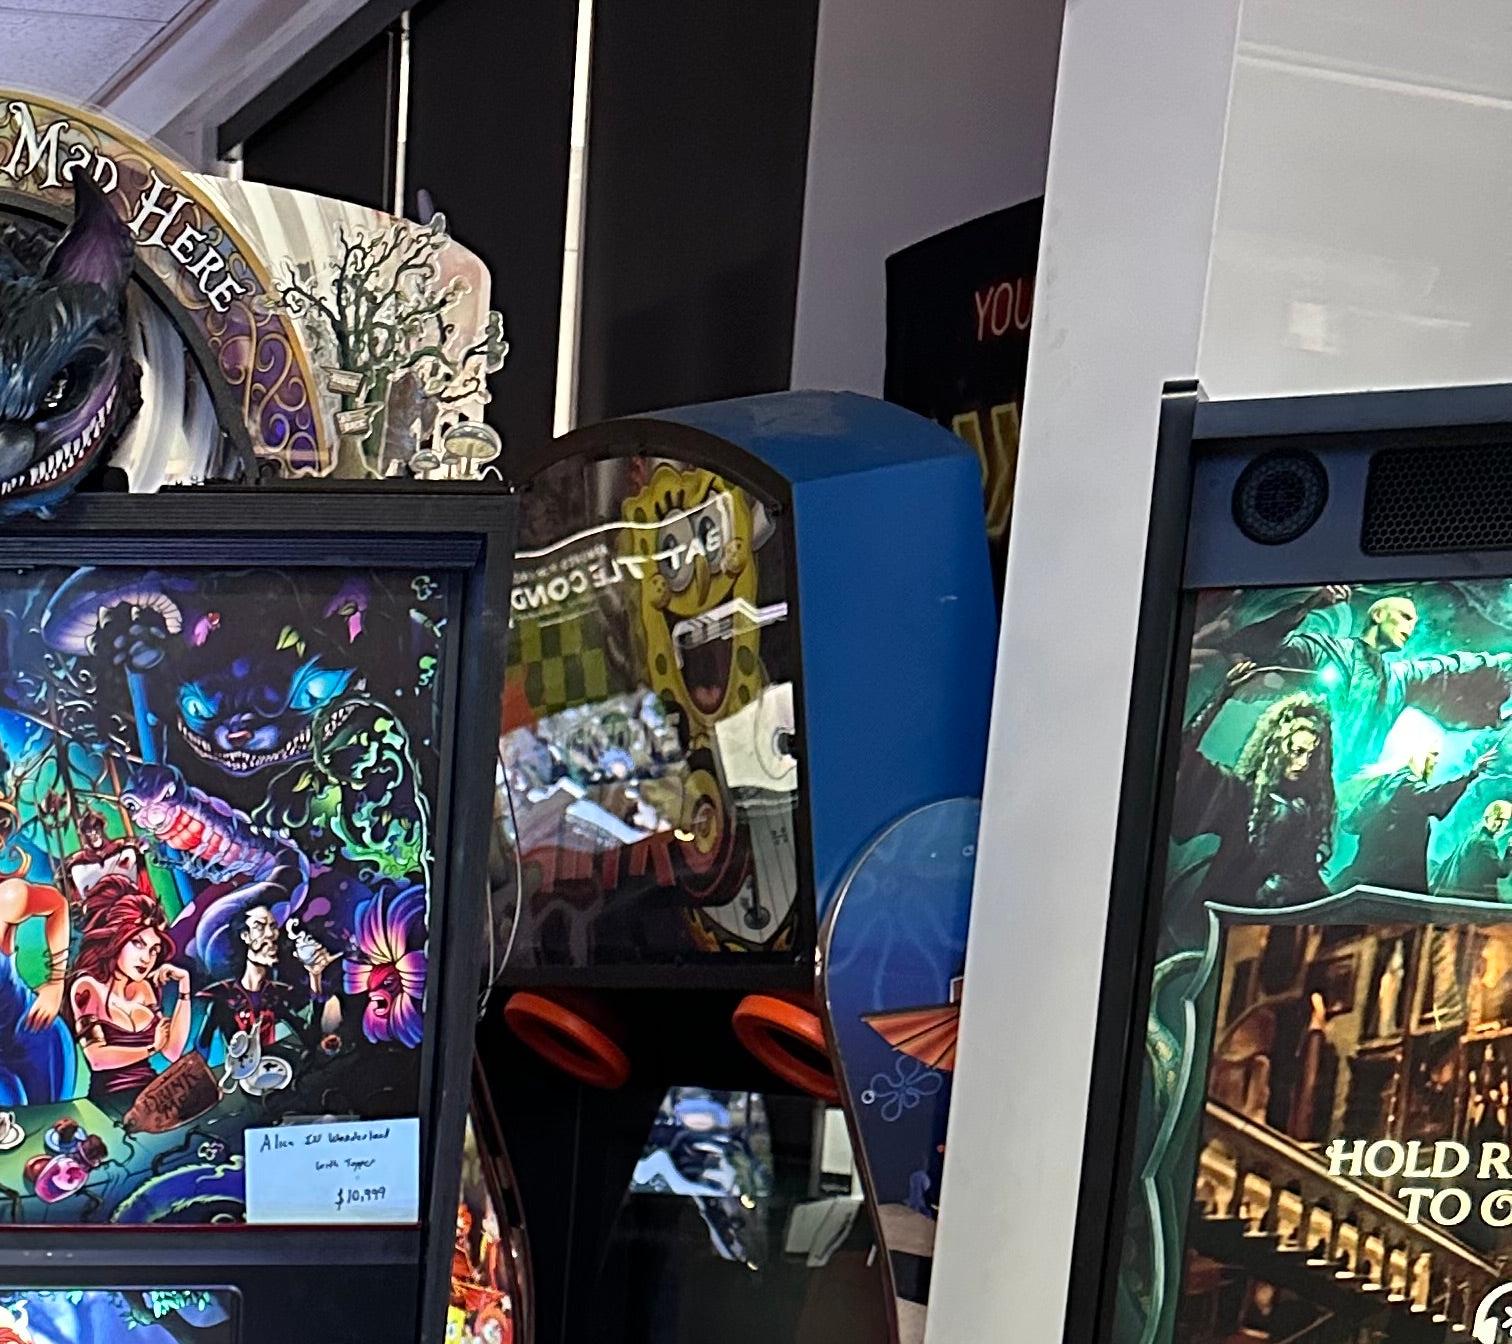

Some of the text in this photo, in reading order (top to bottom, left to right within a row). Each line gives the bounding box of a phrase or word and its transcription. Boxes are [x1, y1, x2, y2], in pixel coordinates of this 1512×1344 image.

[127, 168, 247, 314] HERE
[1325, 1139, 1471, 1178] HOLD
[335, 1186, 386, 1211] $10,999
[1398, 1188, 1472, 1226] TO
